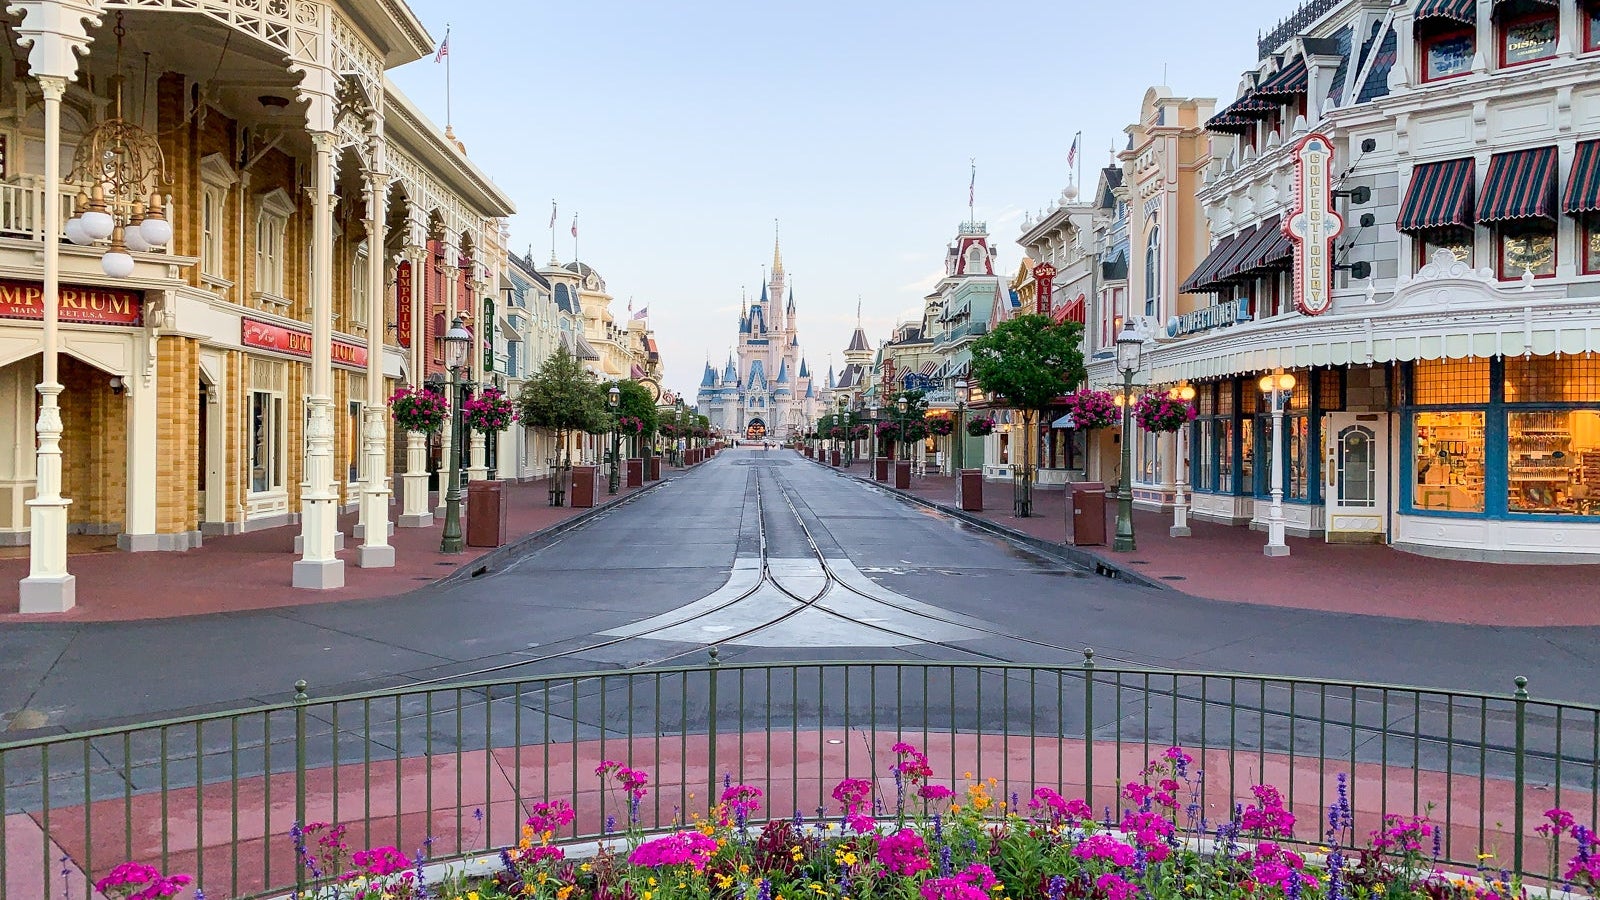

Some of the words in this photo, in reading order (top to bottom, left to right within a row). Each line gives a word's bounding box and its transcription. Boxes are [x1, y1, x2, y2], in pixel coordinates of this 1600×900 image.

[1310, 153, 1321, 302] CONFECTIONERY
[0, 285, 131, 314] MPRIUM
[10, 306, 37, 314] MAIN
[400, 269, 411, 339] EMPORIUM
